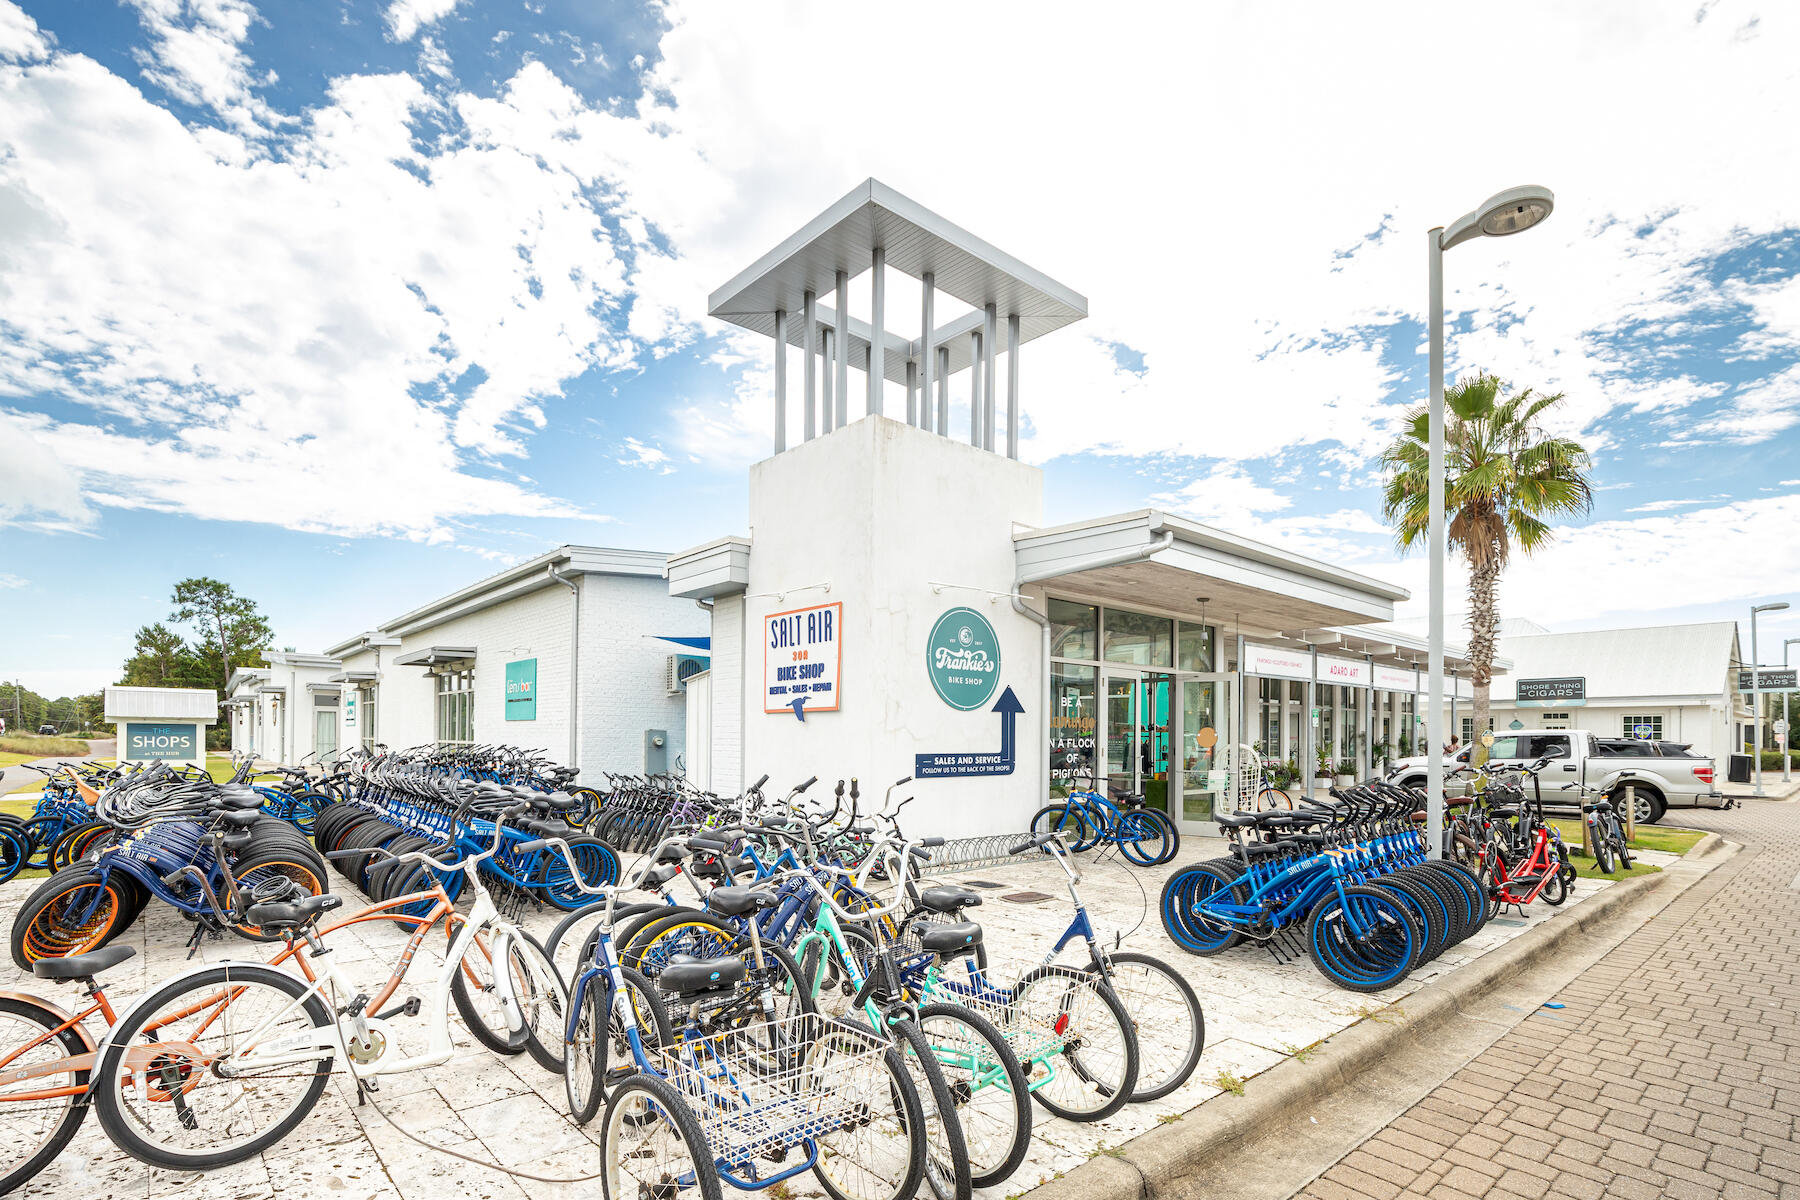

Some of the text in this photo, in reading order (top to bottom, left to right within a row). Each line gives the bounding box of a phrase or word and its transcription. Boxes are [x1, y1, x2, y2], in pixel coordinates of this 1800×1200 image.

[771, 610, 832, 649] SALT AIR
[777, 662, 825, 681] BIKE SHOP
[1329, 664, 1359, 678] ADARO ART
[948, 676, 983, 686] BIKE SHOP
[769, 682, 832, 695] RENTAL SALES REPAIR
[1528, 689, 1573, 697] CIGARS
[1061, 696, 1082, 707] BE A
[1050, 701, 1096, 733] lamingo
[153, 727, 171, 735] THE
[133, 735, 191, 748] SHOPS
[1049, 738, 1096, 748] N A FLOCK
[934, 756, 1001, 765] SALES AND SERVICE
[1066, 753, 1079, 763] OF
[118, 848, 134, 858] SALT
[136, 852, 149, 862] AIR
[1286, 863, 1301, 876] SALT
[1300, 860, 1312, 870] AIR
